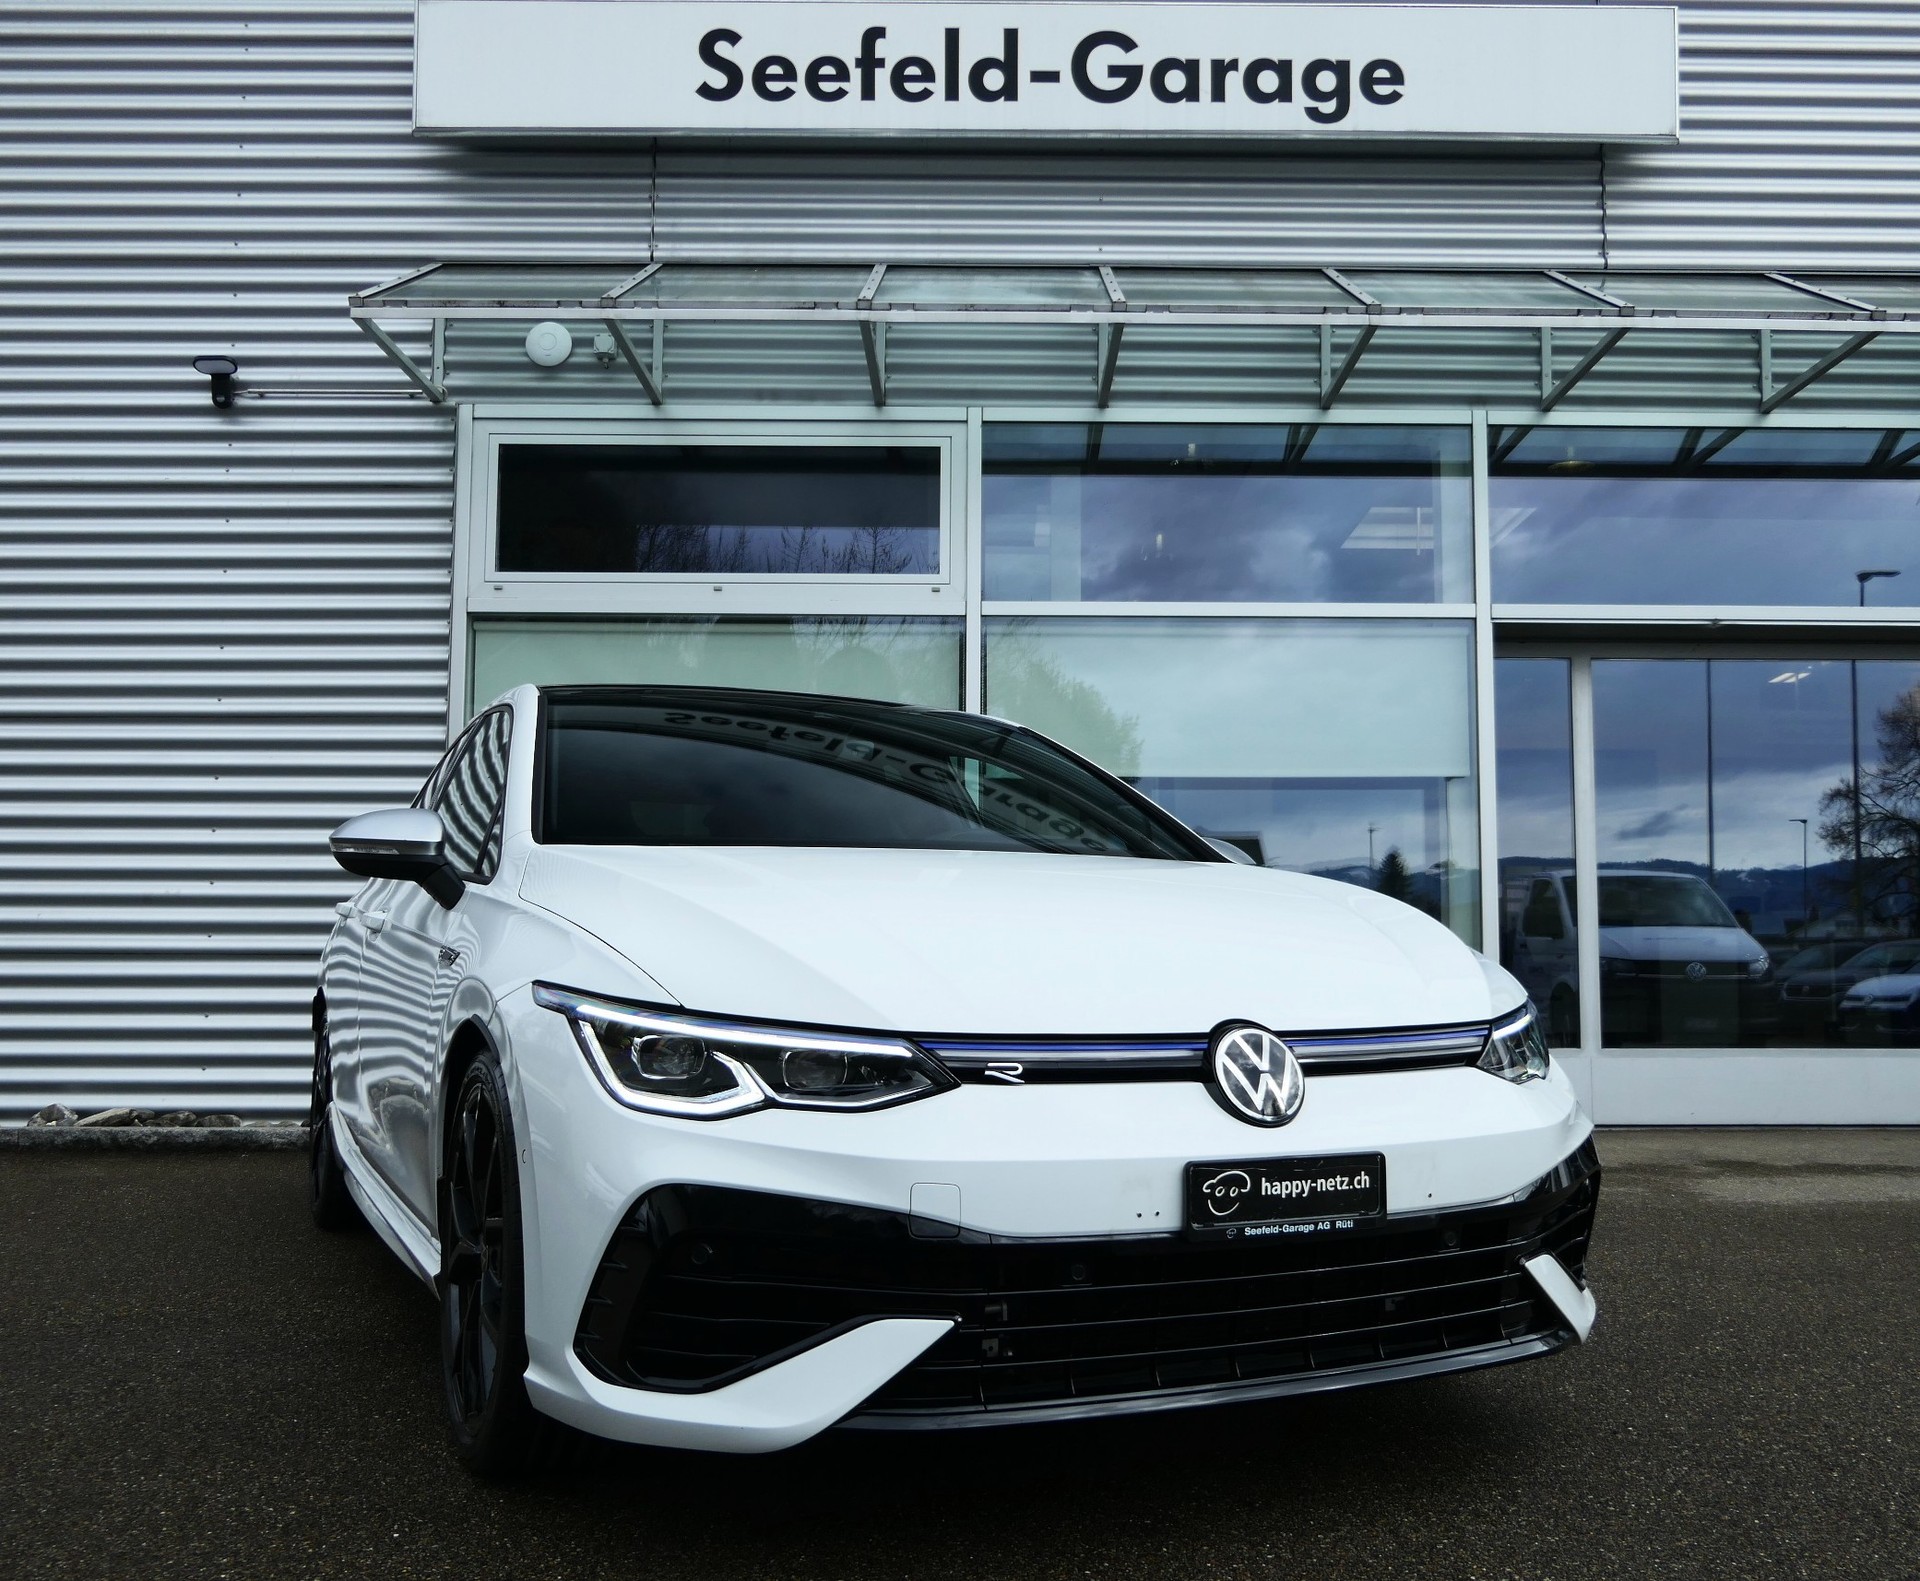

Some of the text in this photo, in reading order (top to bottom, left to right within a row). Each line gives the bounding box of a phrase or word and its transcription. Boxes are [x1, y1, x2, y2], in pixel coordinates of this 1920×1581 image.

[695, 26, 1405, 124] Seefeld-Garage
[1216, 1028, 1304, 1118] VW
[1261, 1171, 1370, 1198] happy-netz.ch
[1244, 1219, 1354, 1236] Seefeld-Garage AG Rüti
